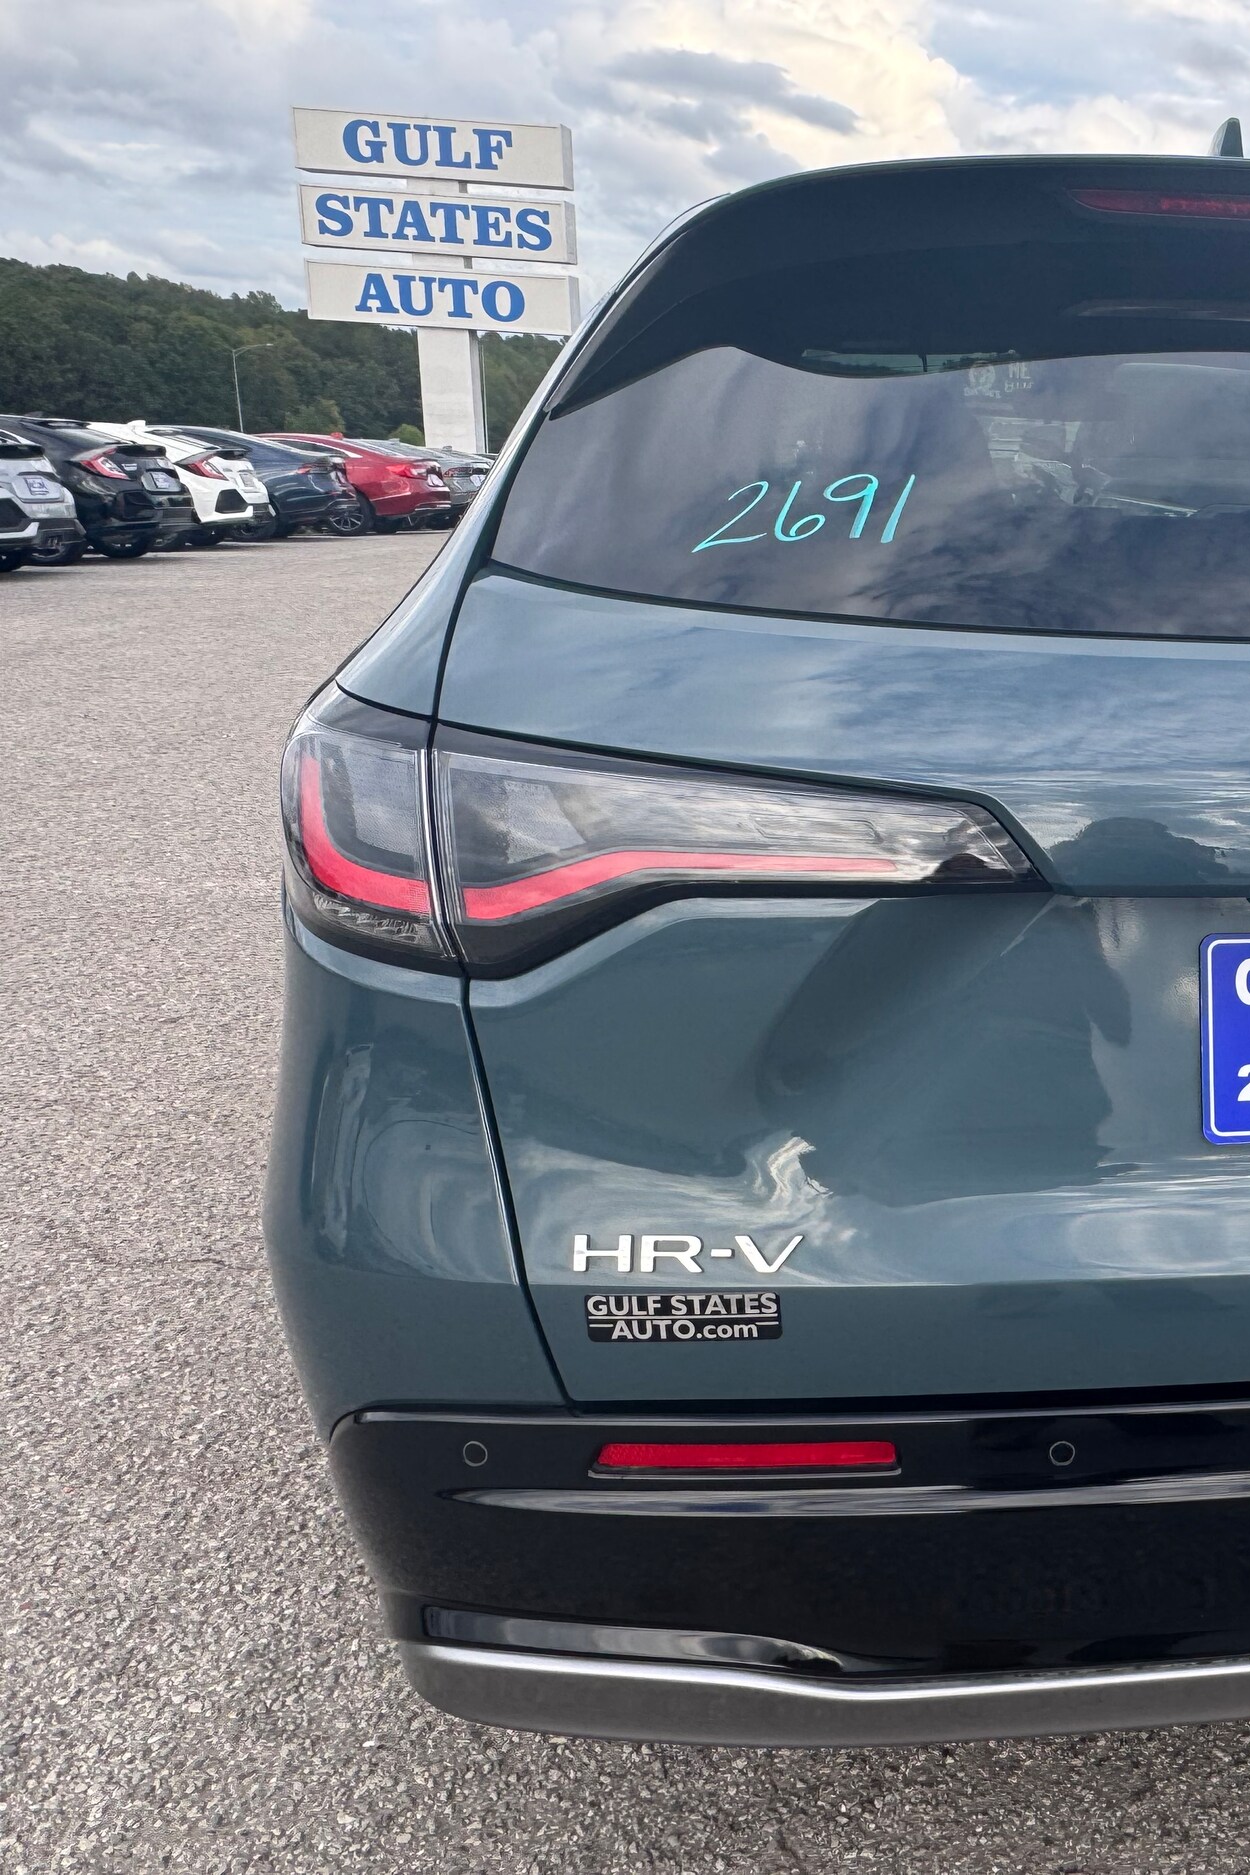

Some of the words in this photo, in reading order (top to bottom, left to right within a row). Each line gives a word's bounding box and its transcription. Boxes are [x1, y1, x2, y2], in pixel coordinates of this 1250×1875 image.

[342, 119, 513, 171] GULF
[315, 193, 553, 251] STATES
[355, 273, 526, 323] AUTO
[690, 473, 916, 553] 2691
[572, 1233, 804, 1274] HR-V
[586, 1295, 662, 1316] GULF
[670, 1292, 778, 1315] STATES
[610, 1319, 759, 1340] AUTO.com
